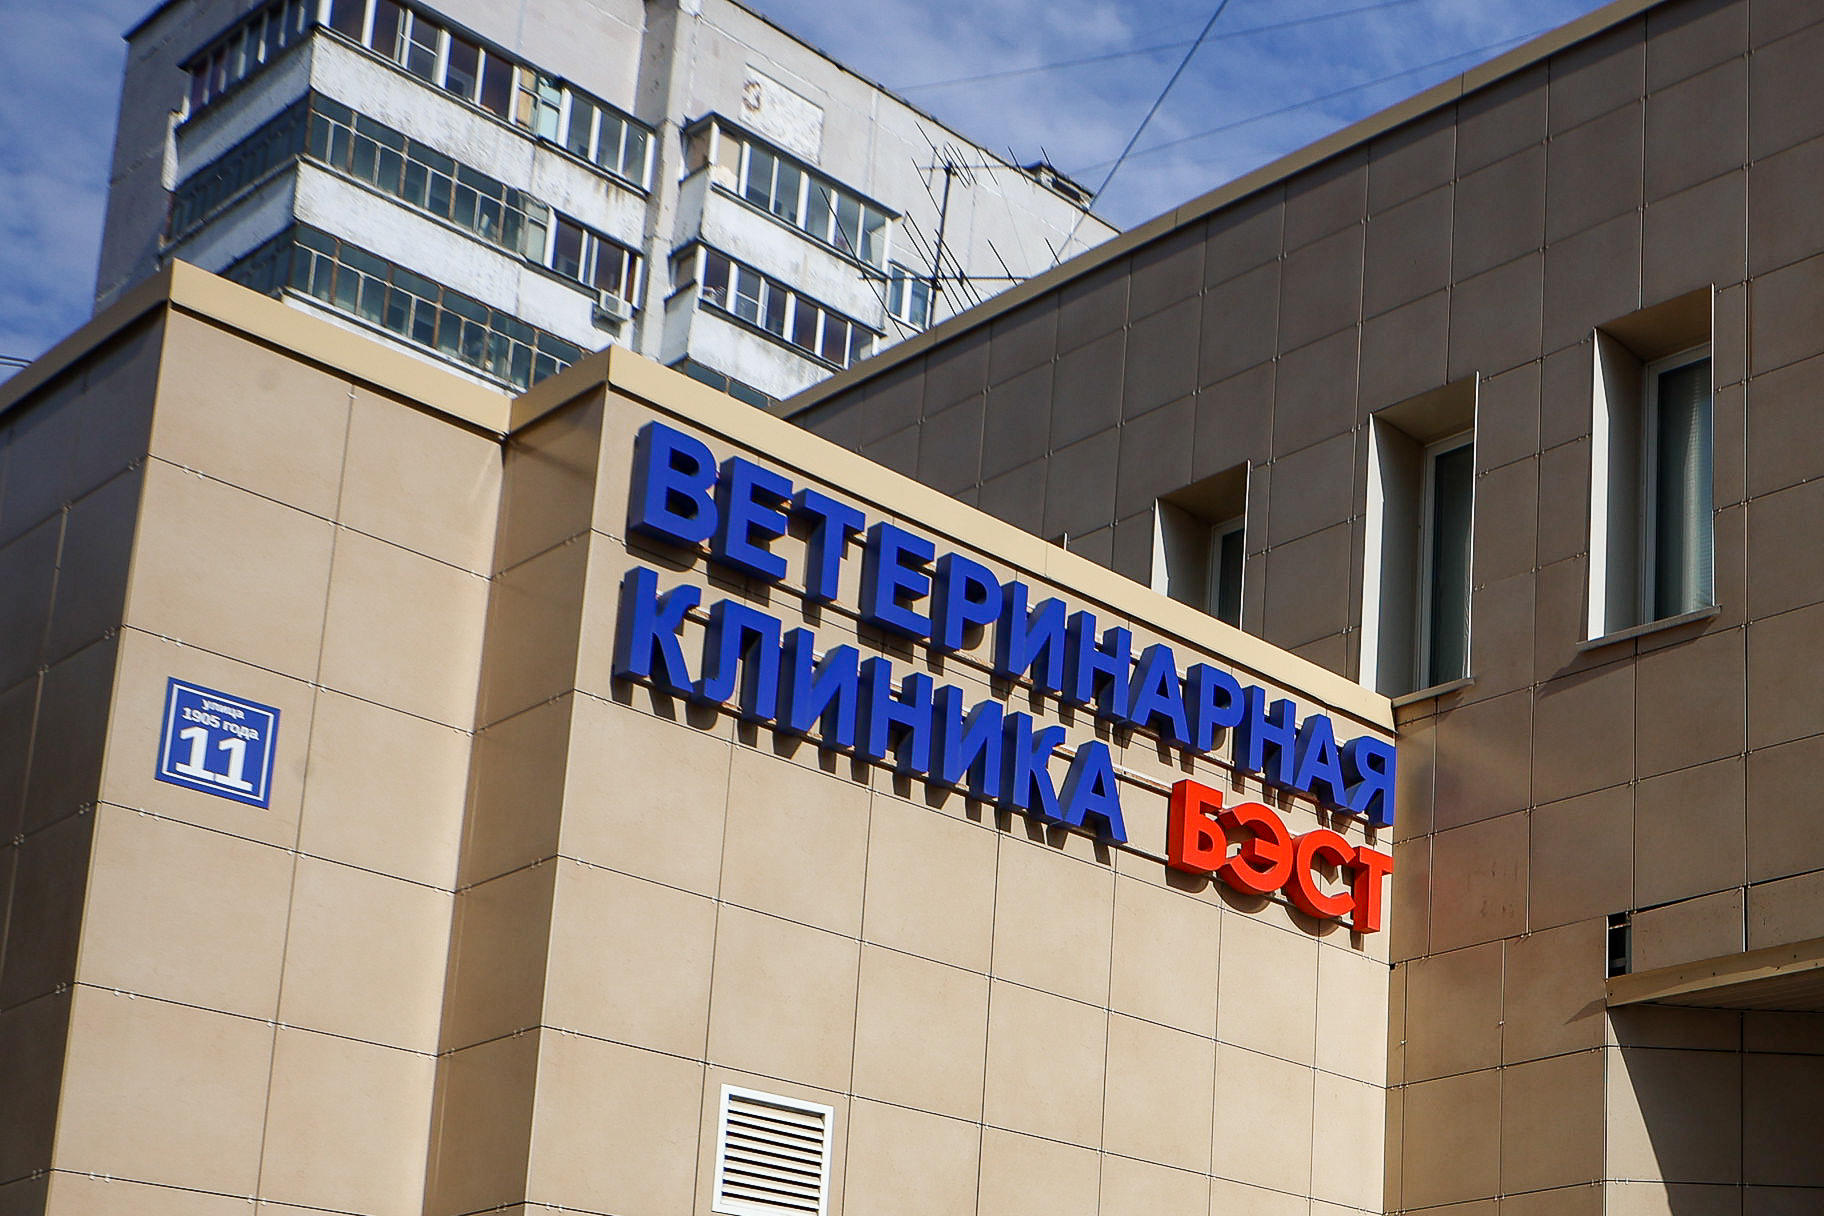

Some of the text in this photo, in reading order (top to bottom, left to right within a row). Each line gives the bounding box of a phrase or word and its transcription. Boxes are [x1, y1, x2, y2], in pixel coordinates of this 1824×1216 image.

[182, 707, 260, 741] 1905 года
[628, 420, 1397, 828] ВЕТЕРИНАРНАЯ
[175, 726, 254, 792] 11
[614, 566, 1394, 934] КЛИНИКА БЭСТ
